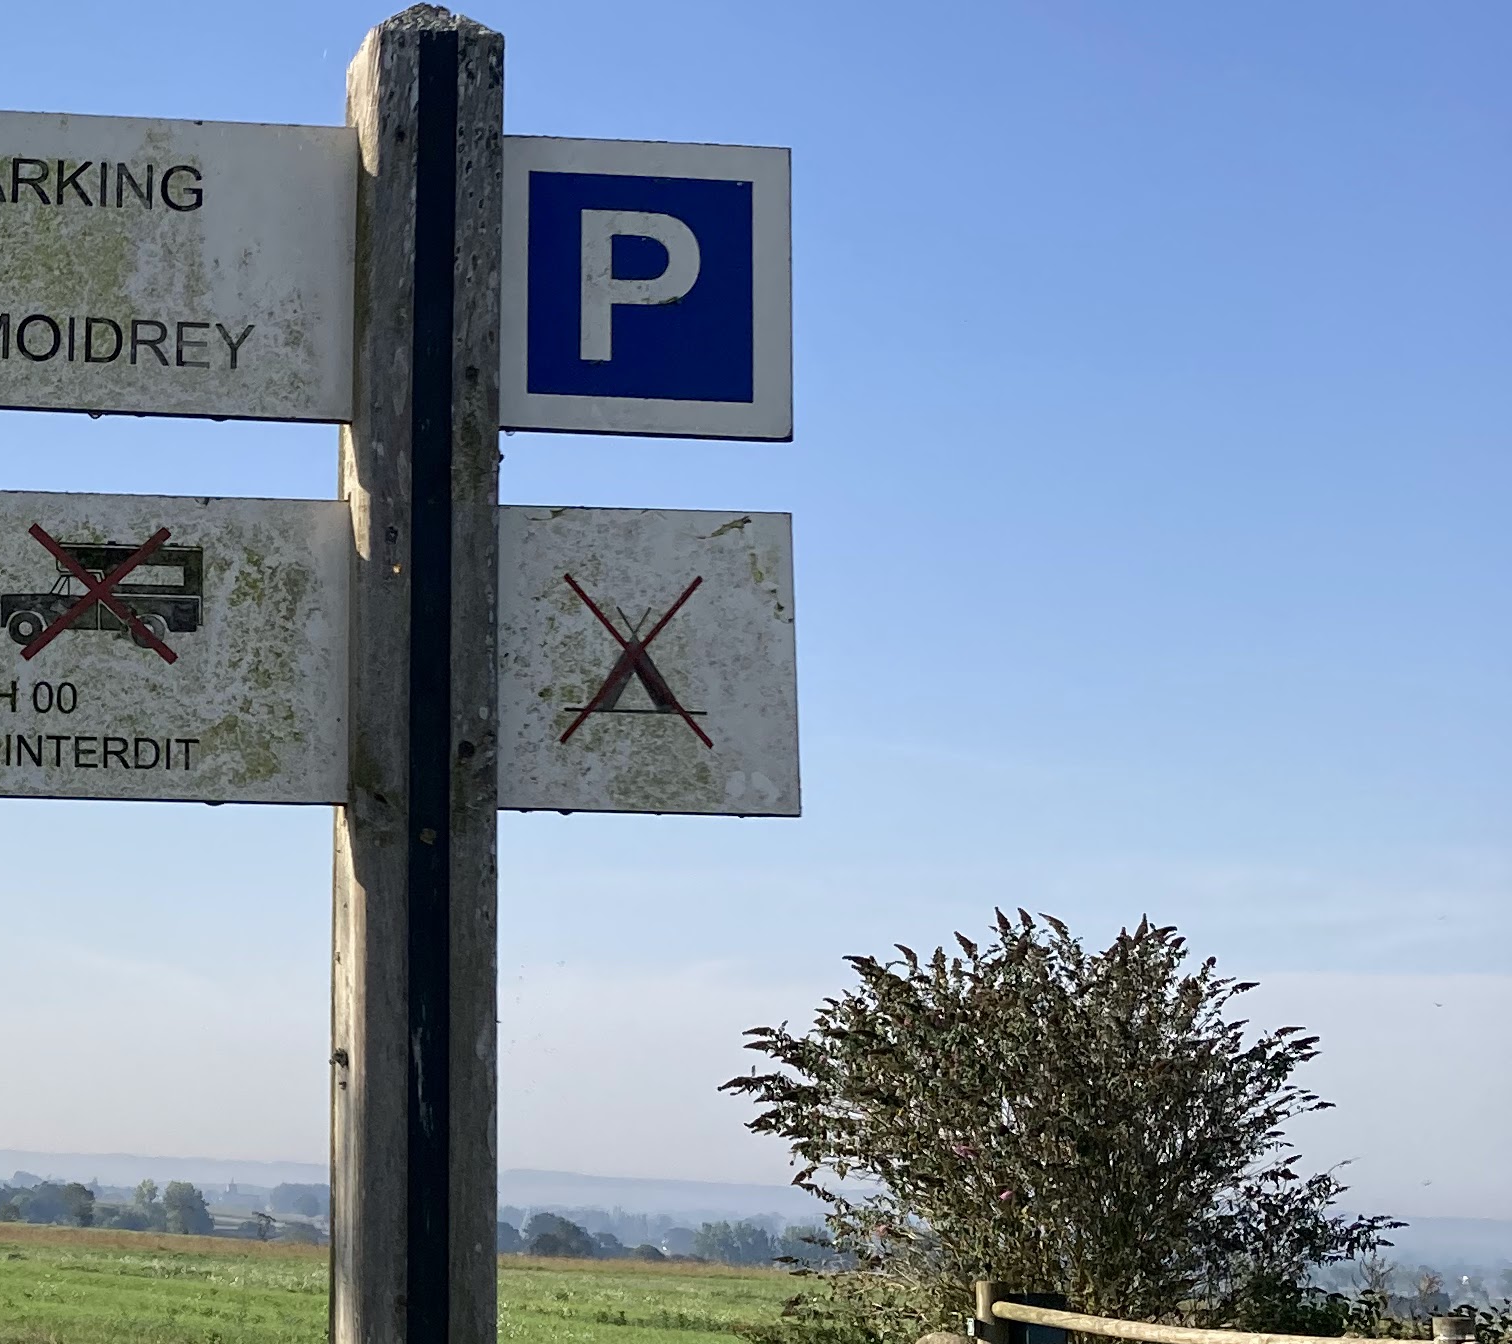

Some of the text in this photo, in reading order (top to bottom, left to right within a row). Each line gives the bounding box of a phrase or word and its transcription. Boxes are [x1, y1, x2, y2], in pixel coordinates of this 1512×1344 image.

[580, 209, 700, 360] P
[31, 681, 78, 715] 00
[5, 734, 200, 771] INTERDIT
